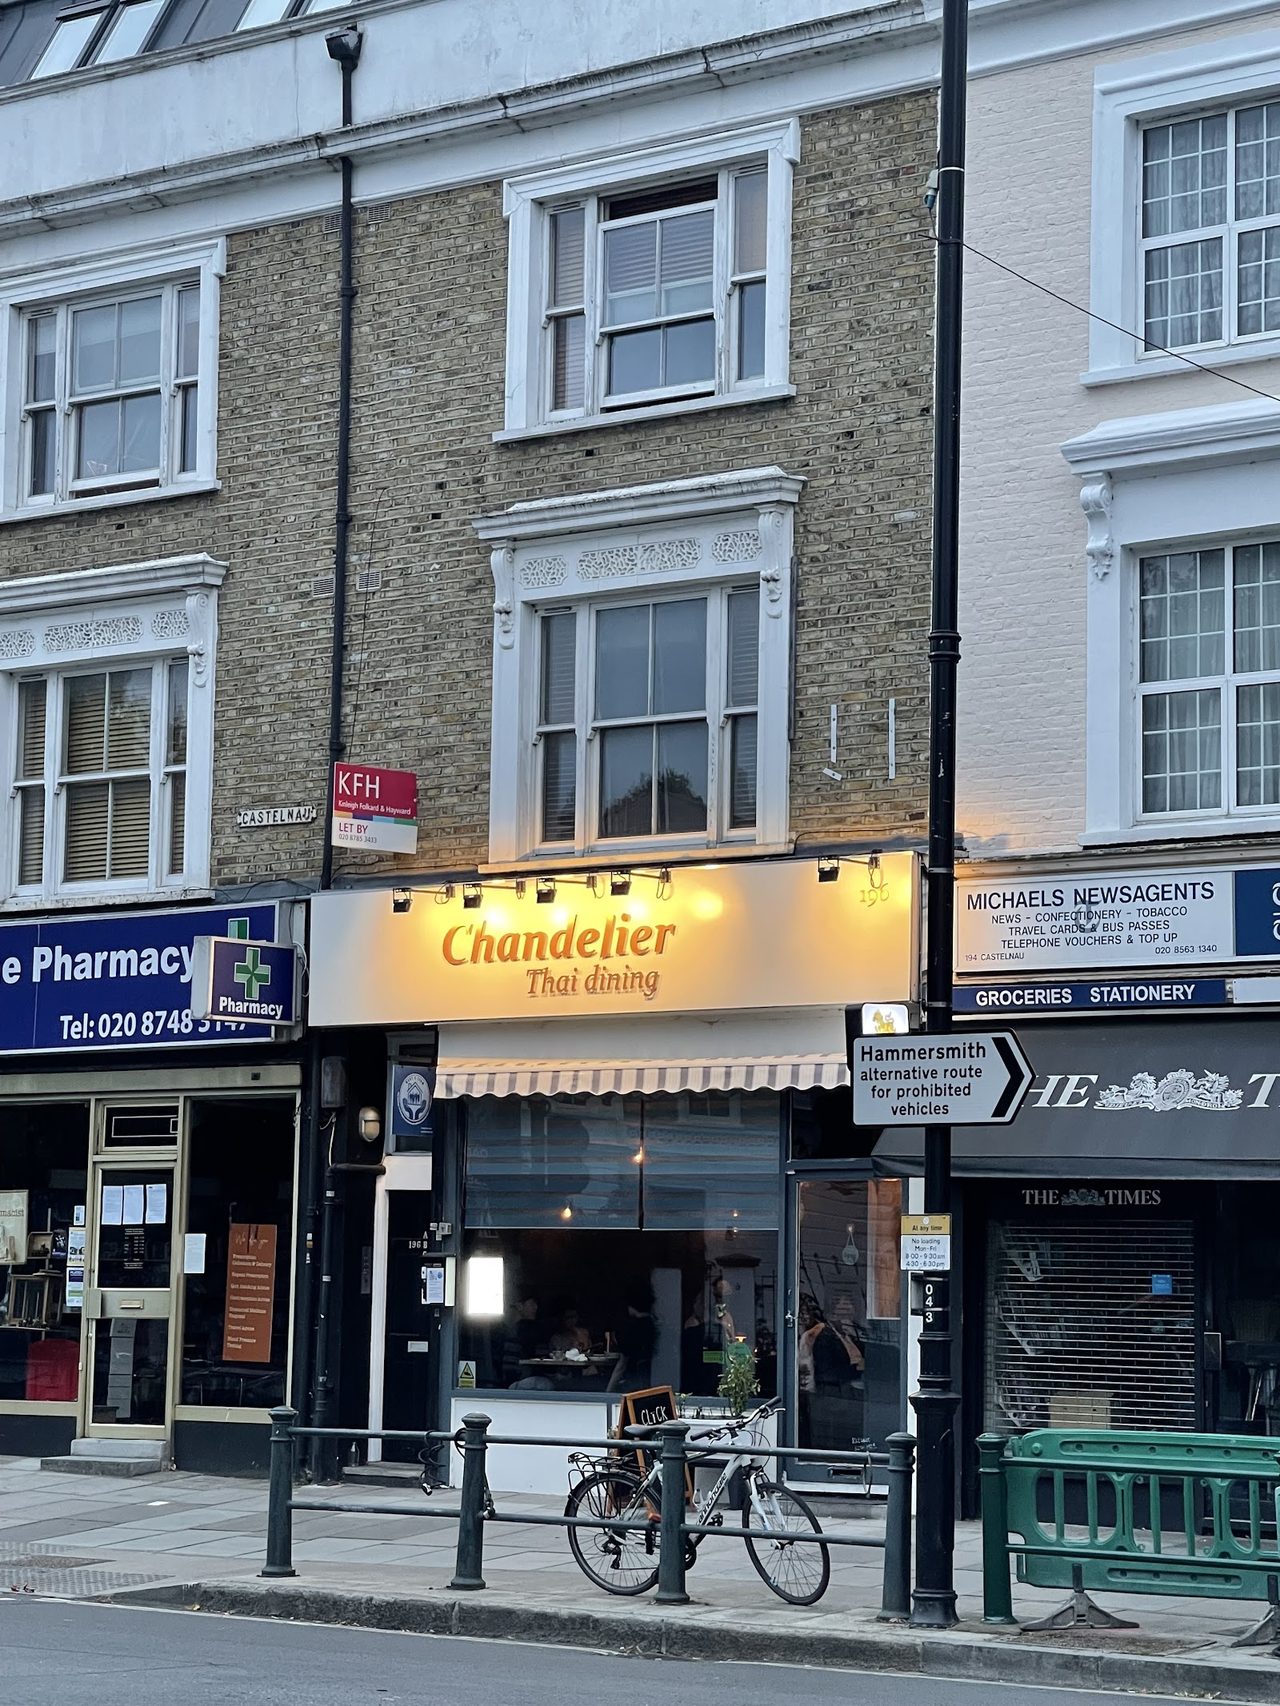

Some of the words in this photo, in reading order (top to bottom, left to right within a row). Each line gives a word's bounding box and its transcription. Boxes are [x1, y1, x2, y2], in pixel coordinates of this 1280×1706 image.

[339, 771, 379, 798] KFH
[242, 808, 311, 825] CASTELNAU
[360, 803, 379, 812] Folkard
[386, 806, 411, 815] Hayward
[339, 822, 354, 833] LET
[357, 824, 368, 834] BY
[339, 833, 348, 841] 020
[859, 882, 889, 907] 196
[967, 889, 1064, 910] MICHAELS
[1074, 881, 1214, 906] NEWSAGENTS
[991, 914, 1021, 924] NEWS
[1035, 909, 1122, 922] CONFECTIONERY
[1137, 906, 1187, 918] TOBACCO
[1009, 926, 1046, 936] TRAVEL
[1050, 924, 1085, 935] CARDS
[1091, 923, 1098, 932] &
[1102, 922, 1124, 932] BUS
[1129, 920, 1170, 931] PASSES
[442, 913, 676, 966] Chandelier
[1001, 938, 1061, 949] TELEPHONE
[1065, 935, 1122, 946] VOUCHERS
[1126, 935, 1133, 944] &
[1139, 934, 1159, 944] TOP
[1163, 933, 1178, 943] UP
[981, 952, 1024, 961] CASTELNAU
[1155, 946, 1171, 954] 020
[1174, 945, 1194, 953] 8563
[1199, 944, 1217, 952] 1340
[32, 945, 195, 983] Pharmacy
[527, 967, 578, 996] Thai
[584, 964, 660, 1000] dining
[976, 988, 1072, 1006] GROCERIES
[1090, 984, 1195, 1003] STATIONERY
[219, 997, 283, 1020] Pharmacy
[60, 1012, 95, 1040] Tel:
[98, 1012, 136, 1037] 020
[142, 1009, 193, 1035] 8748
[861, 1042, 986, 1062] Hammersmith
[860, 1066, 938, 1081] alternative
[944, 1065, 982, 1079] route
[871, 1085, 891, 1098] for
[897, 1083, 971, 1100] prohibited
[891, 1101, 949, 1116] vehicles
[1022, 1189, 1059, 1205] THE
[1104, 1189, 1162, 1205] TIMES
[408, 1241, 421, 1249] 196
